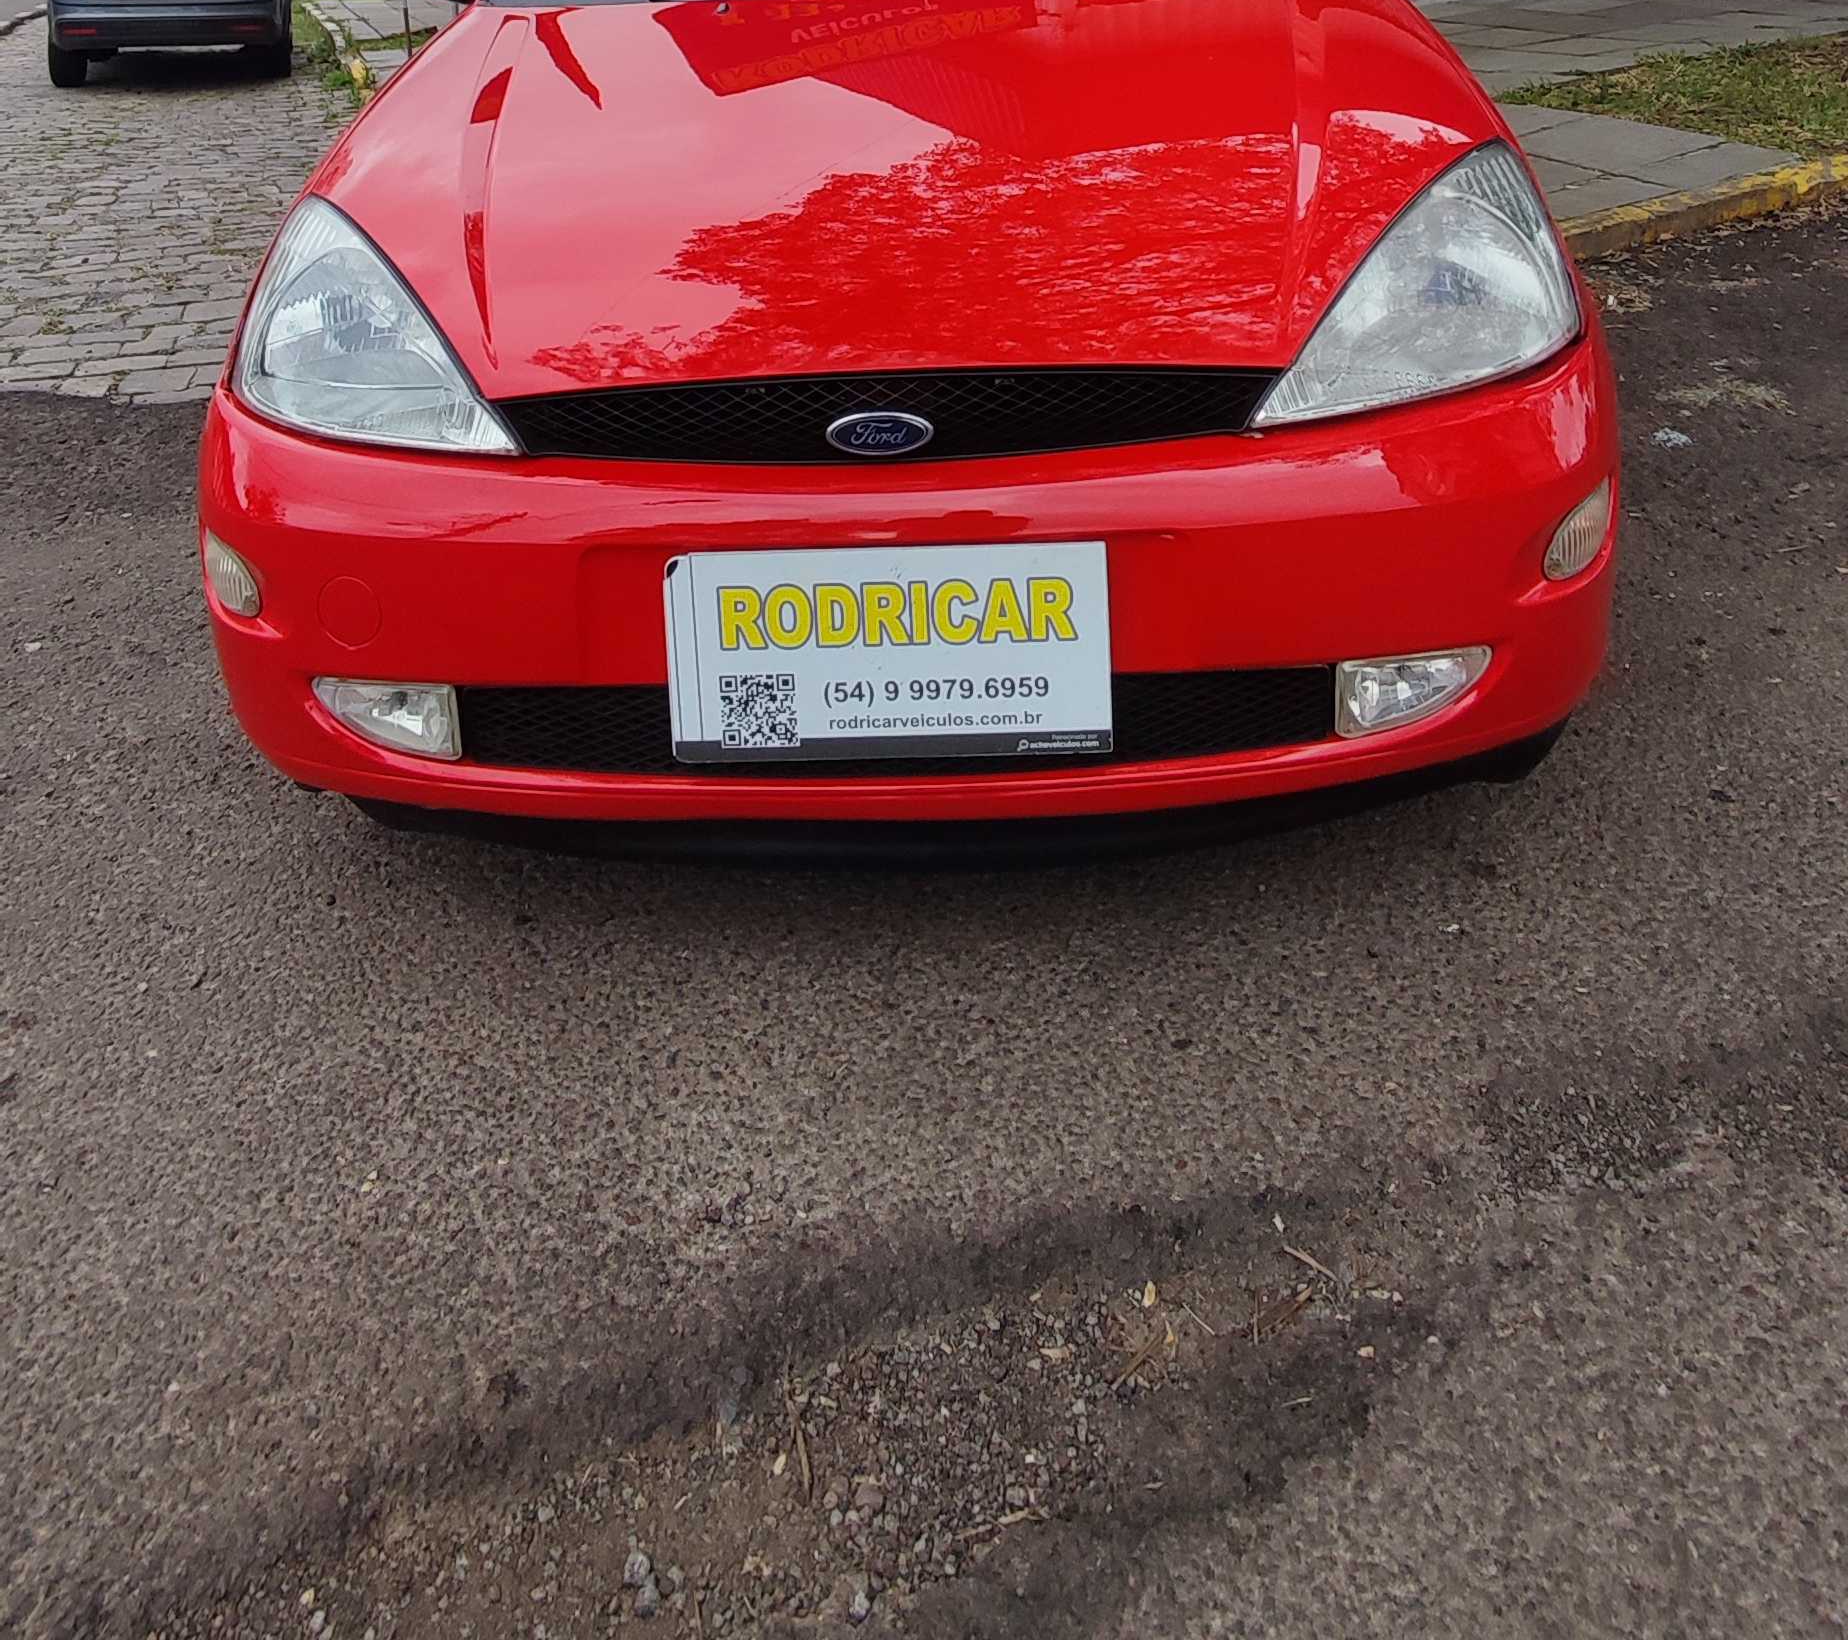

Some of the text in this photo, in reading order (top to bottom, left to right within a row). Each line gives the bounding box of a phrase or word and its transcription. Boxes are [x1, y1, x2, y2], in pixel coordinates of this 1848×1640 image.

[850, 422, 908, 444] Ford
[716, 577, 1078, 650] RODRICAR
[823, 676, 1050, 708] (54) 9 9979.6959
[829, 710, 1043, 731] rodricarveiculos.com.br
